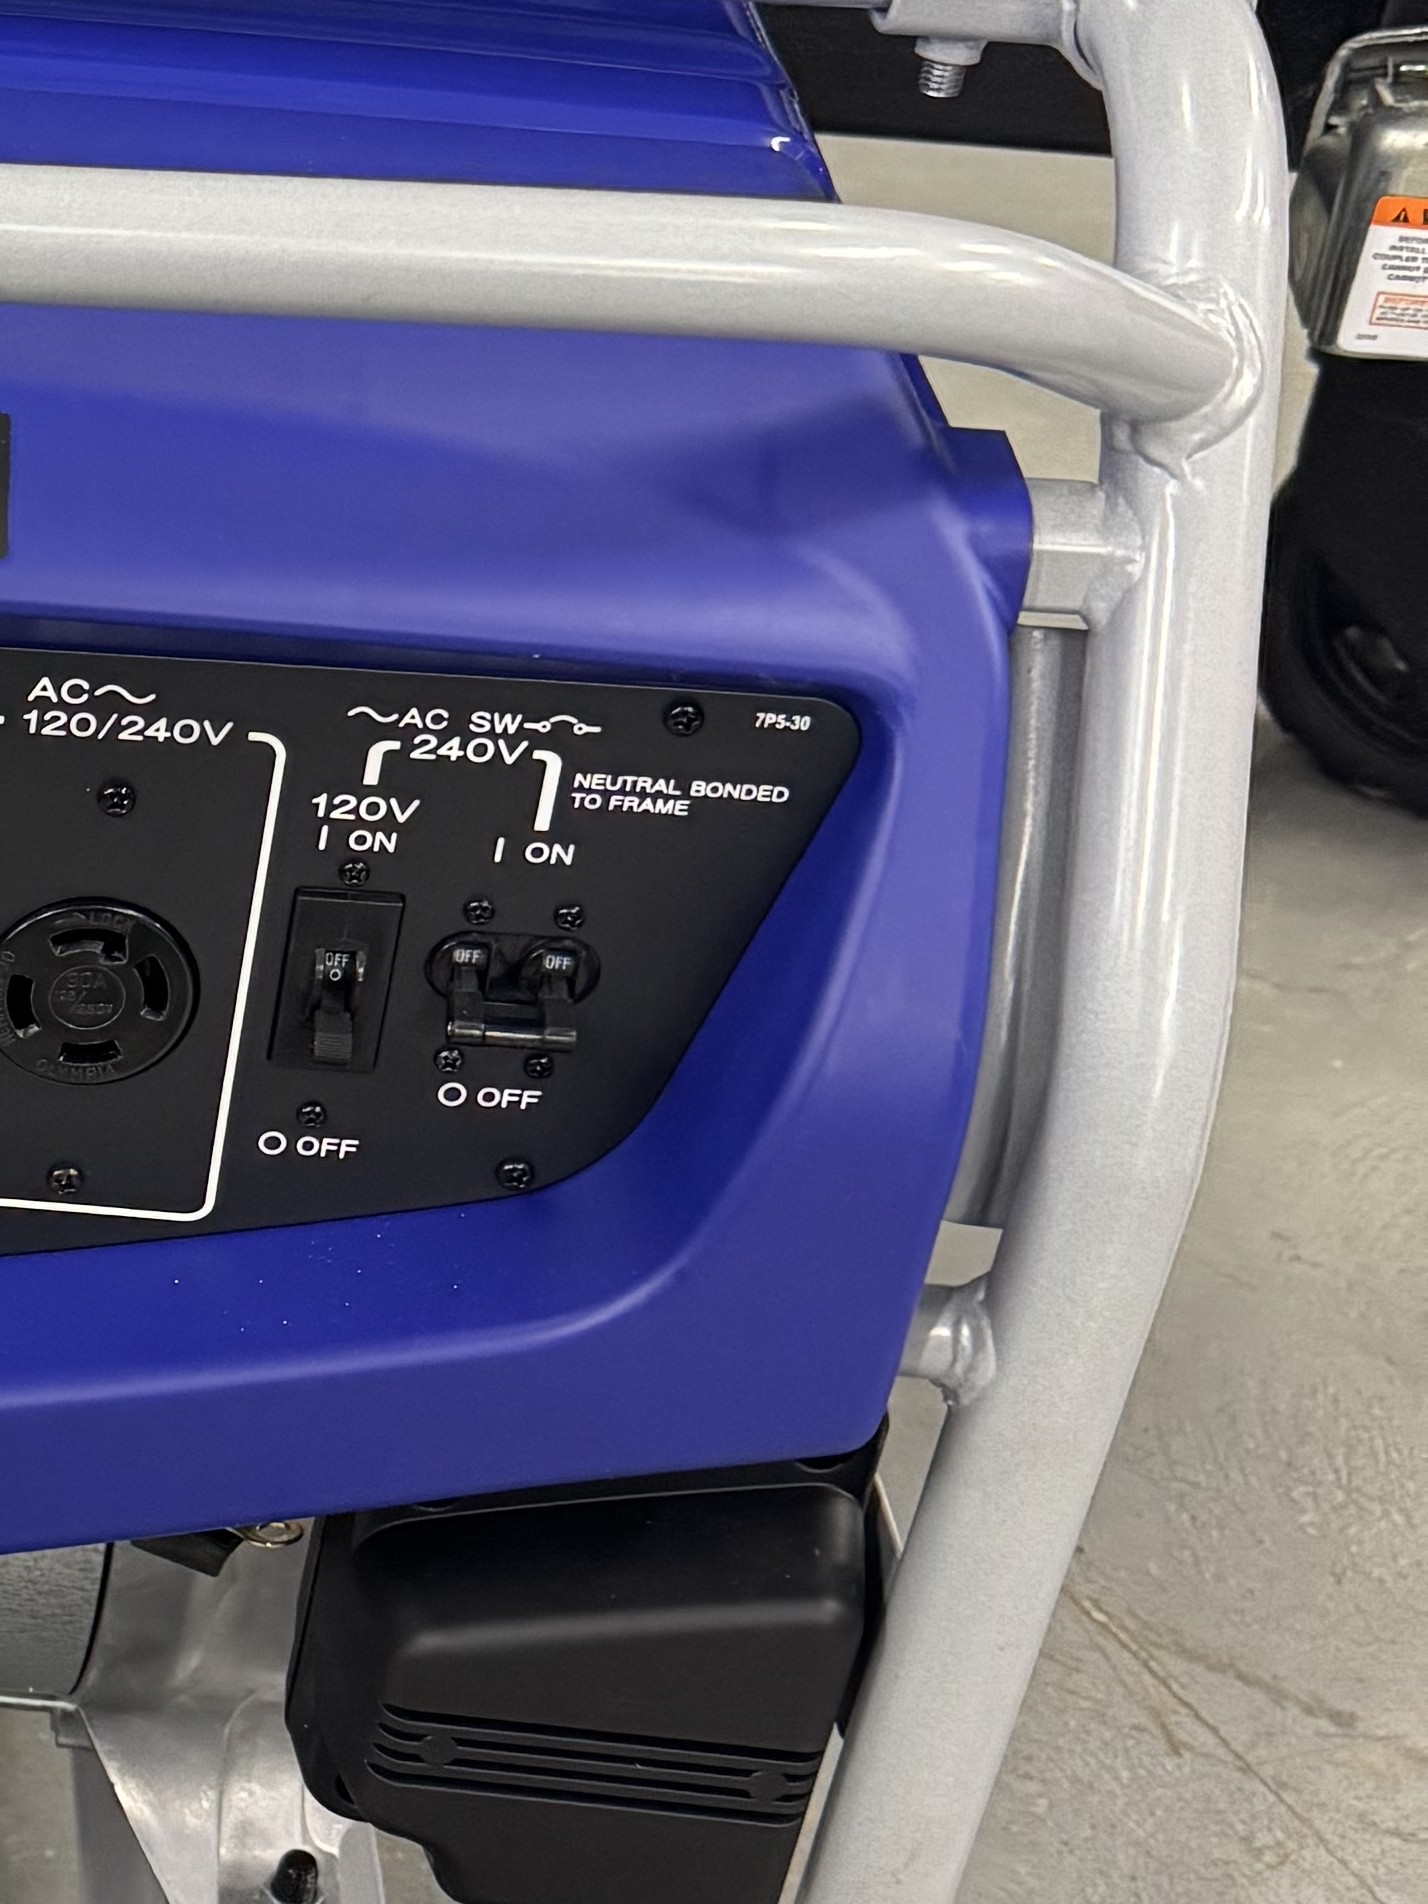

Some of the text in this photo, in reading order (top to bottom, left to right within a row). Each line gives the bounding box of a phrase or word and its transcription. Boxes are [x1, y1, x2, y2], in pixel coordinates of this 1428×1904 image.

[27, 676, 90, 705] AC
[22, 709, 234, 746] 120/240V
[398, 707, 523, 735] AC SW
[754, 711, 811, 731] 7P5-30
[409, 733, 529, 765] 240V
[573, 772, 790, 803] NEUTRAL BONDED
[311, 792, 421, 824] 120V
[570, 792, 691, 816] TO FRAME
[348, 829, 398, 854] ON
[524, 841, 576, 866] ON
[325, 952, 350, 968] OFF
[454, 948, 480, 964] OFF
[545, 955, 571, 971] OFF
[476, 1087, 543, 1110] OFF
[296, 1135, 360, 1160] OFF
